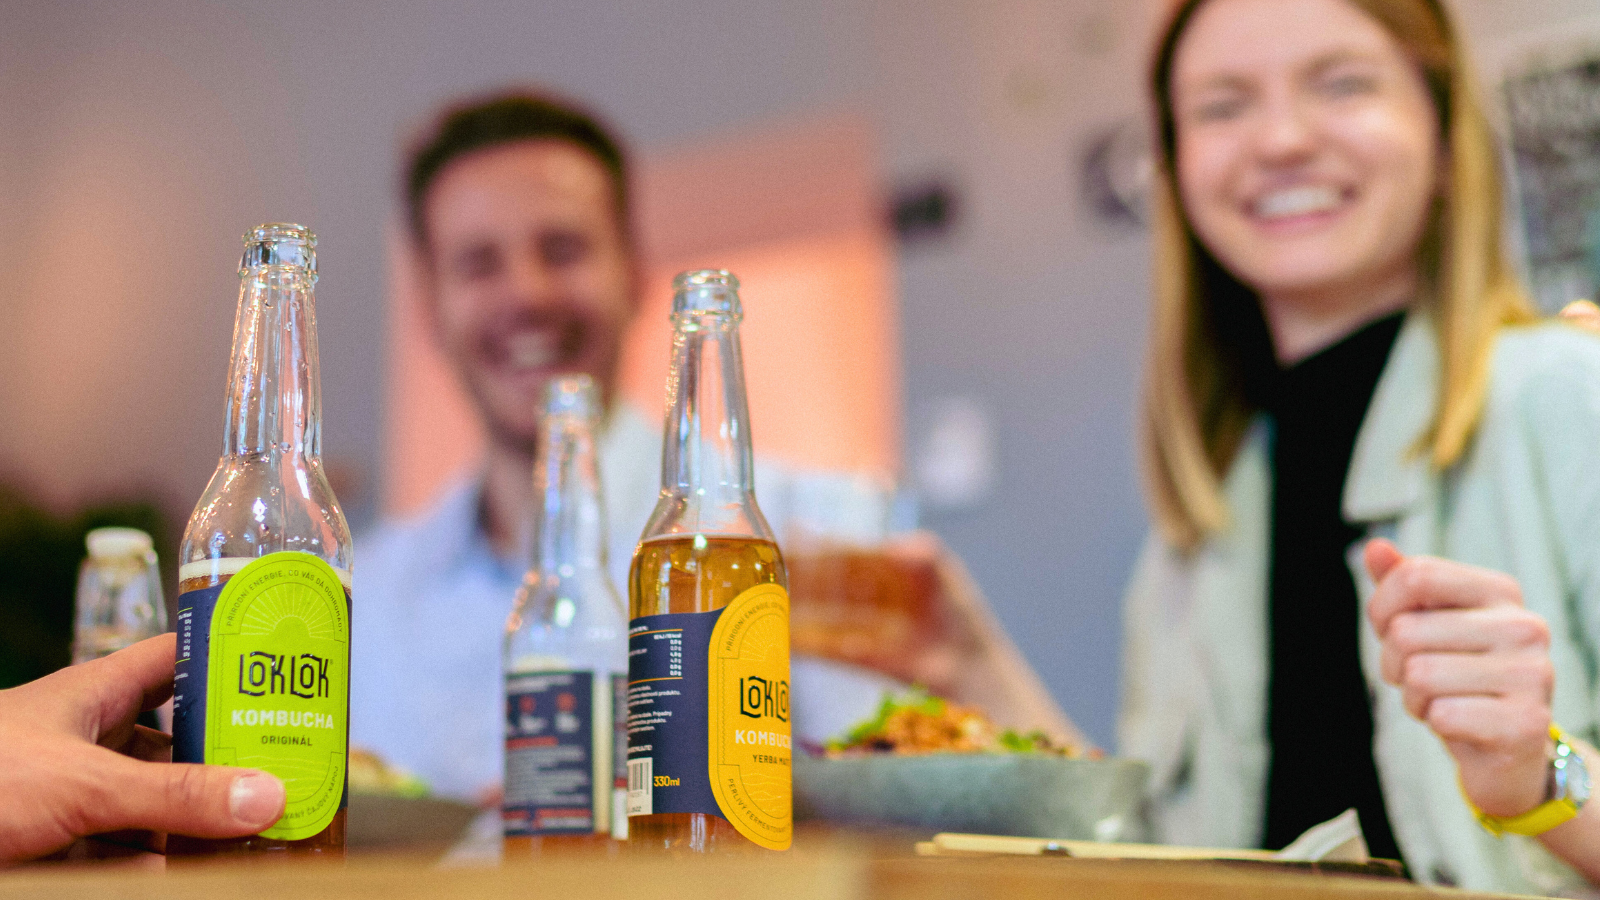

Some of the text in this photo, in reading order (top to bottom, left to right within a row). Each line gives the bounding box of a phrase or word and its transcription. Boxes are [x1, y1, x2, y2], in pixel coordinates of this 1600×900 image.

[288, 569, 299, 577] CO
[301, 570, 315, 581] VÁS
[315, 577, 324, 588] DÁ
[324, 586, 343, 633] DOHROMADY
[231, 709, 334, 730] KOMBUCHA
[261, 735, 313, 747] ORIGINÁL
[752, 754, 791, 767] YERBA MAT
